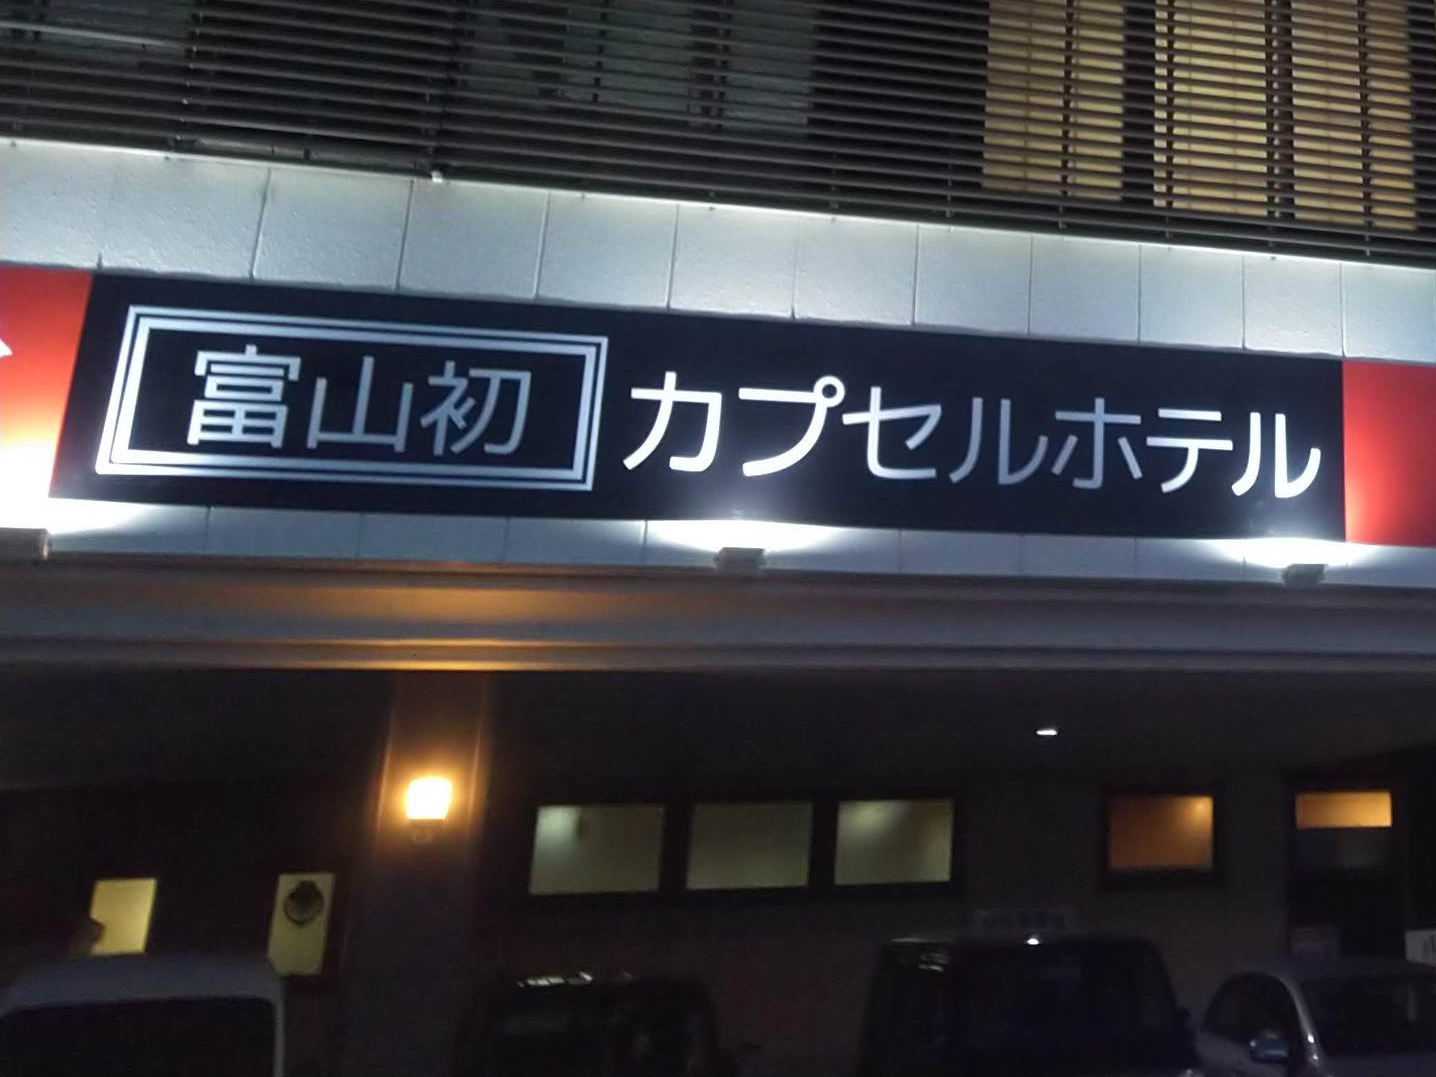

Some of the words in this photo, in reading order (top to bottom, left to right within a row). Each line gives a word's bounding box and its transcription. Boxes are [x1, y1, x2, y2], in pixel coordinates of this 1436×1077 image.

[187, 344, 532, 457] 富山初
[623, 370, 1321, 499] カプセルホテル
